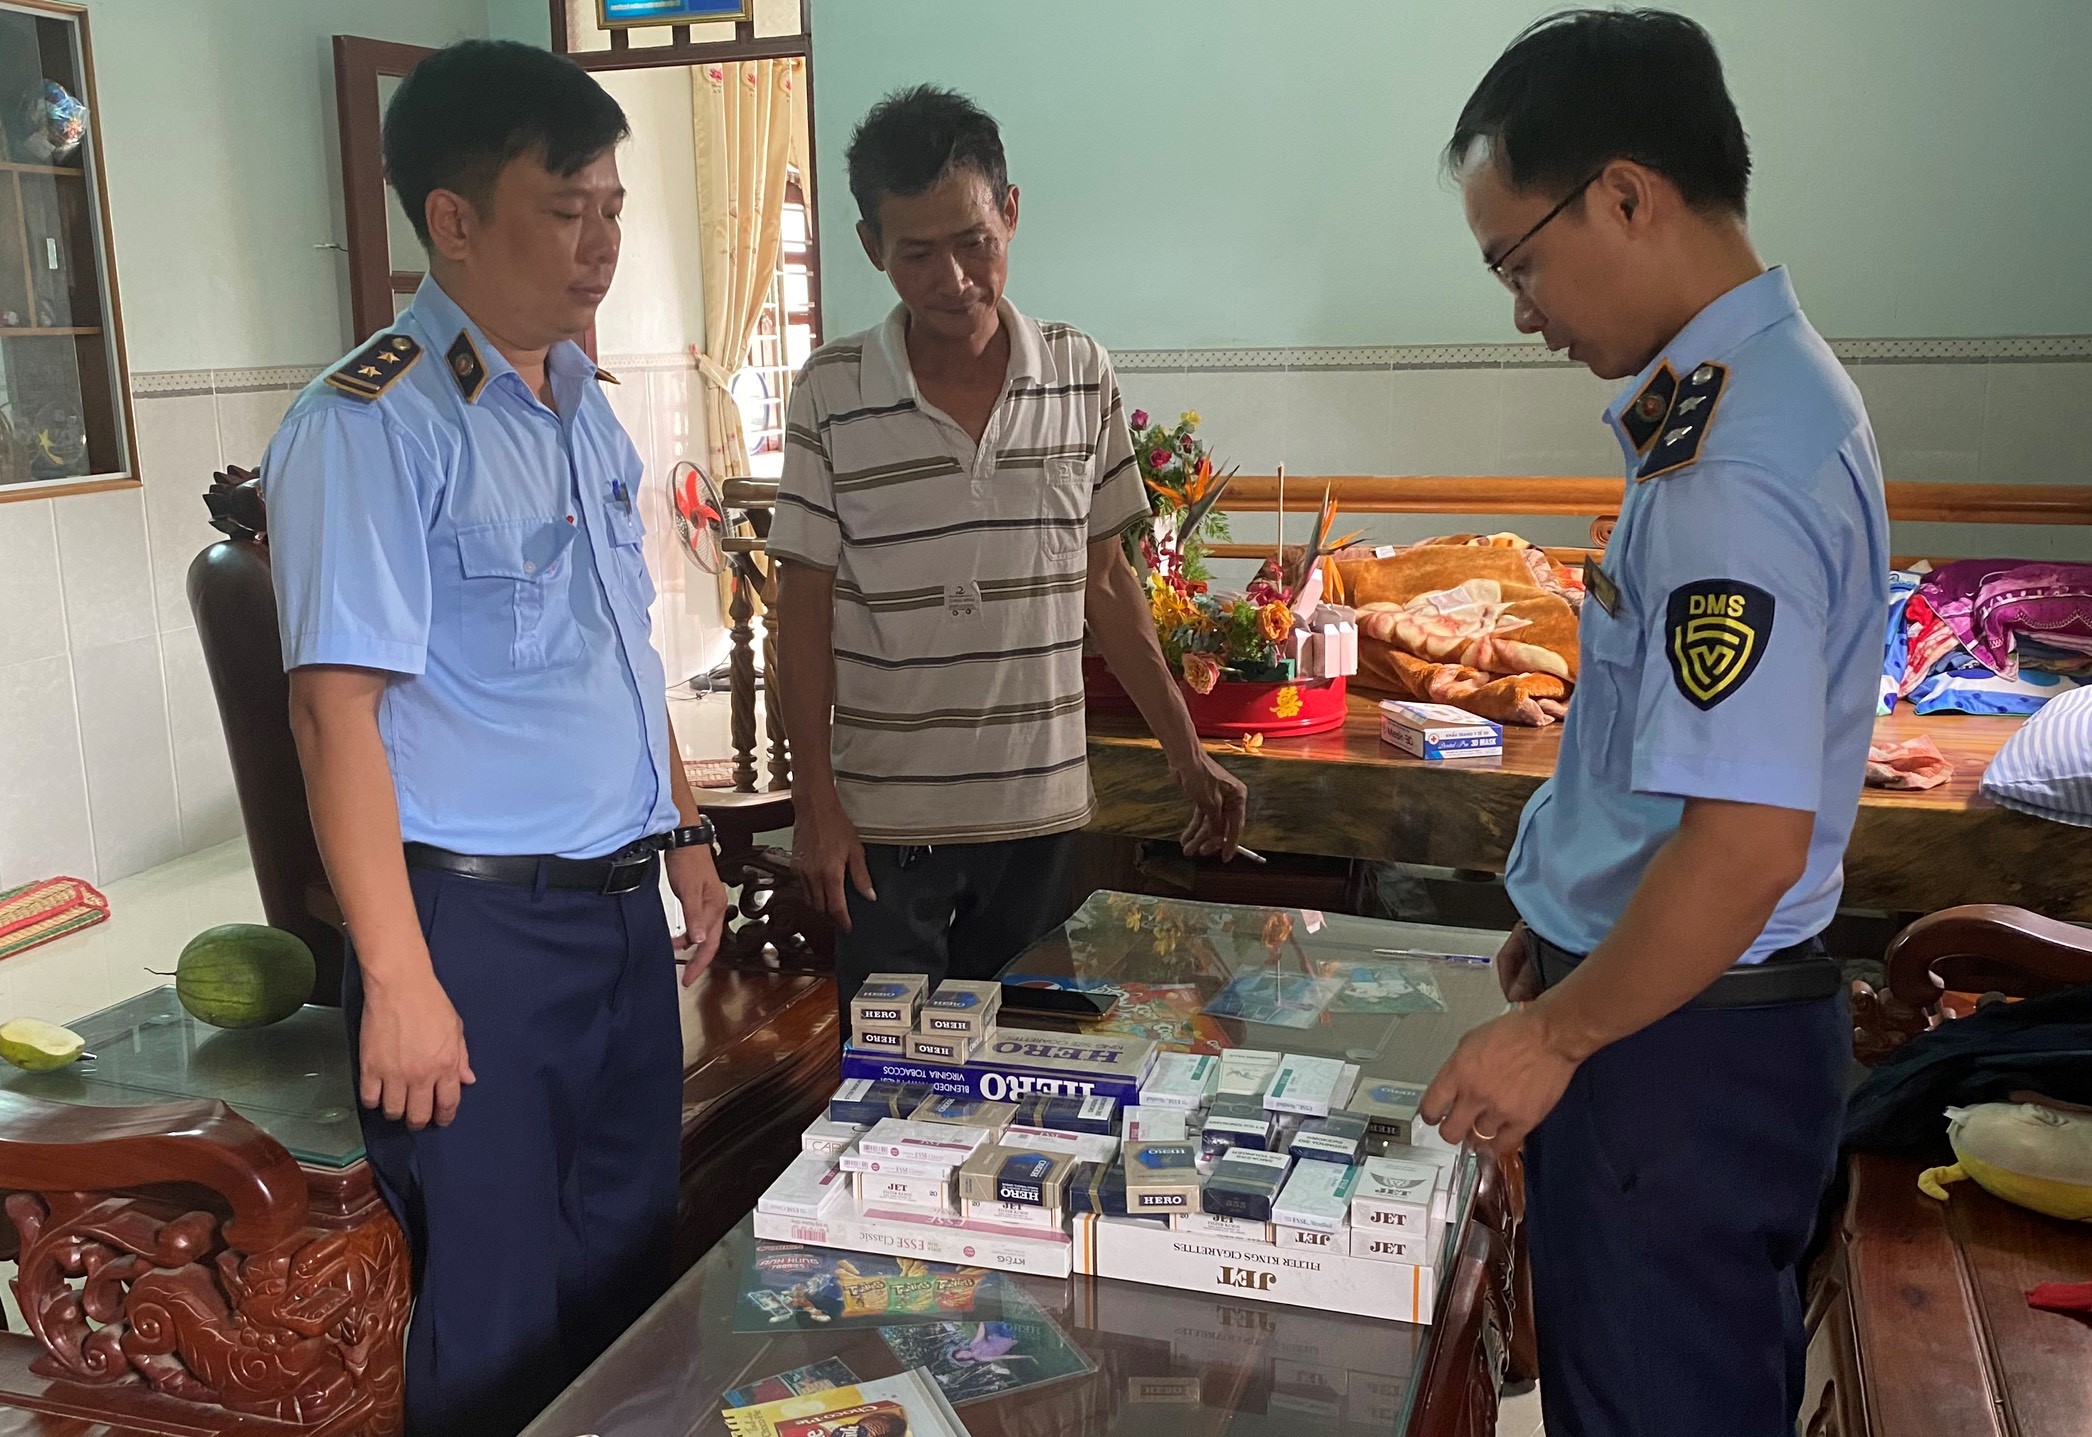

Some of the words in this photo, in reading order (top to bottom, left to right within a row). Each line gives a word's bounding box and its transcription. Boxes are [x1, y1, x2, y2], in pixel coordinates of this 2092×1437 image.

[1689, 594, 1746, 617] DMS
[864, 1010, 897, 1020] HERO
[934, 1020, 967, 1030] HERO
[865, 1034, 897, 1044] HERO
[918, 1044, 949, 1056] HERO
[991, 1042, 1125, 1063] HERO
[882, 1065, 928, 1079] TOBACCOS
[928, 1070, 965, 1082] VIRGINIA
[933, 1083, 970, 1094] BLENDED
[979, 1072, 1096, 1102] HERO
[1147, 1147, 1186, 1156] HERO
[887, 1182, 908, 1192] JET
[1000, 1188, 1040, 1201] HERO
[1143, 1195, 1183, 1206] HERO
[1002, 1202, 1024, 1210] JET
[924, 1216, 966, 1227] ESSE
[1370, 1211, 1407, 1226] JET
[859, 1232, 895, 1246] Classic
[896, 1237, 925, 1250] ESSE
[1294, 1231, 1331, 1246] JET
[1173, 1242, 1242, 1261] CIGARETTES
[1369, 1241, 1407, 1255] JET
[996, 1255, 1026, 1266] KT&G
[1243, 1252, 1280, 1266] KINGS
[1282, 1258, 1321, 1271] FILTER
[1216, 1265, 1277, 1291] JET
